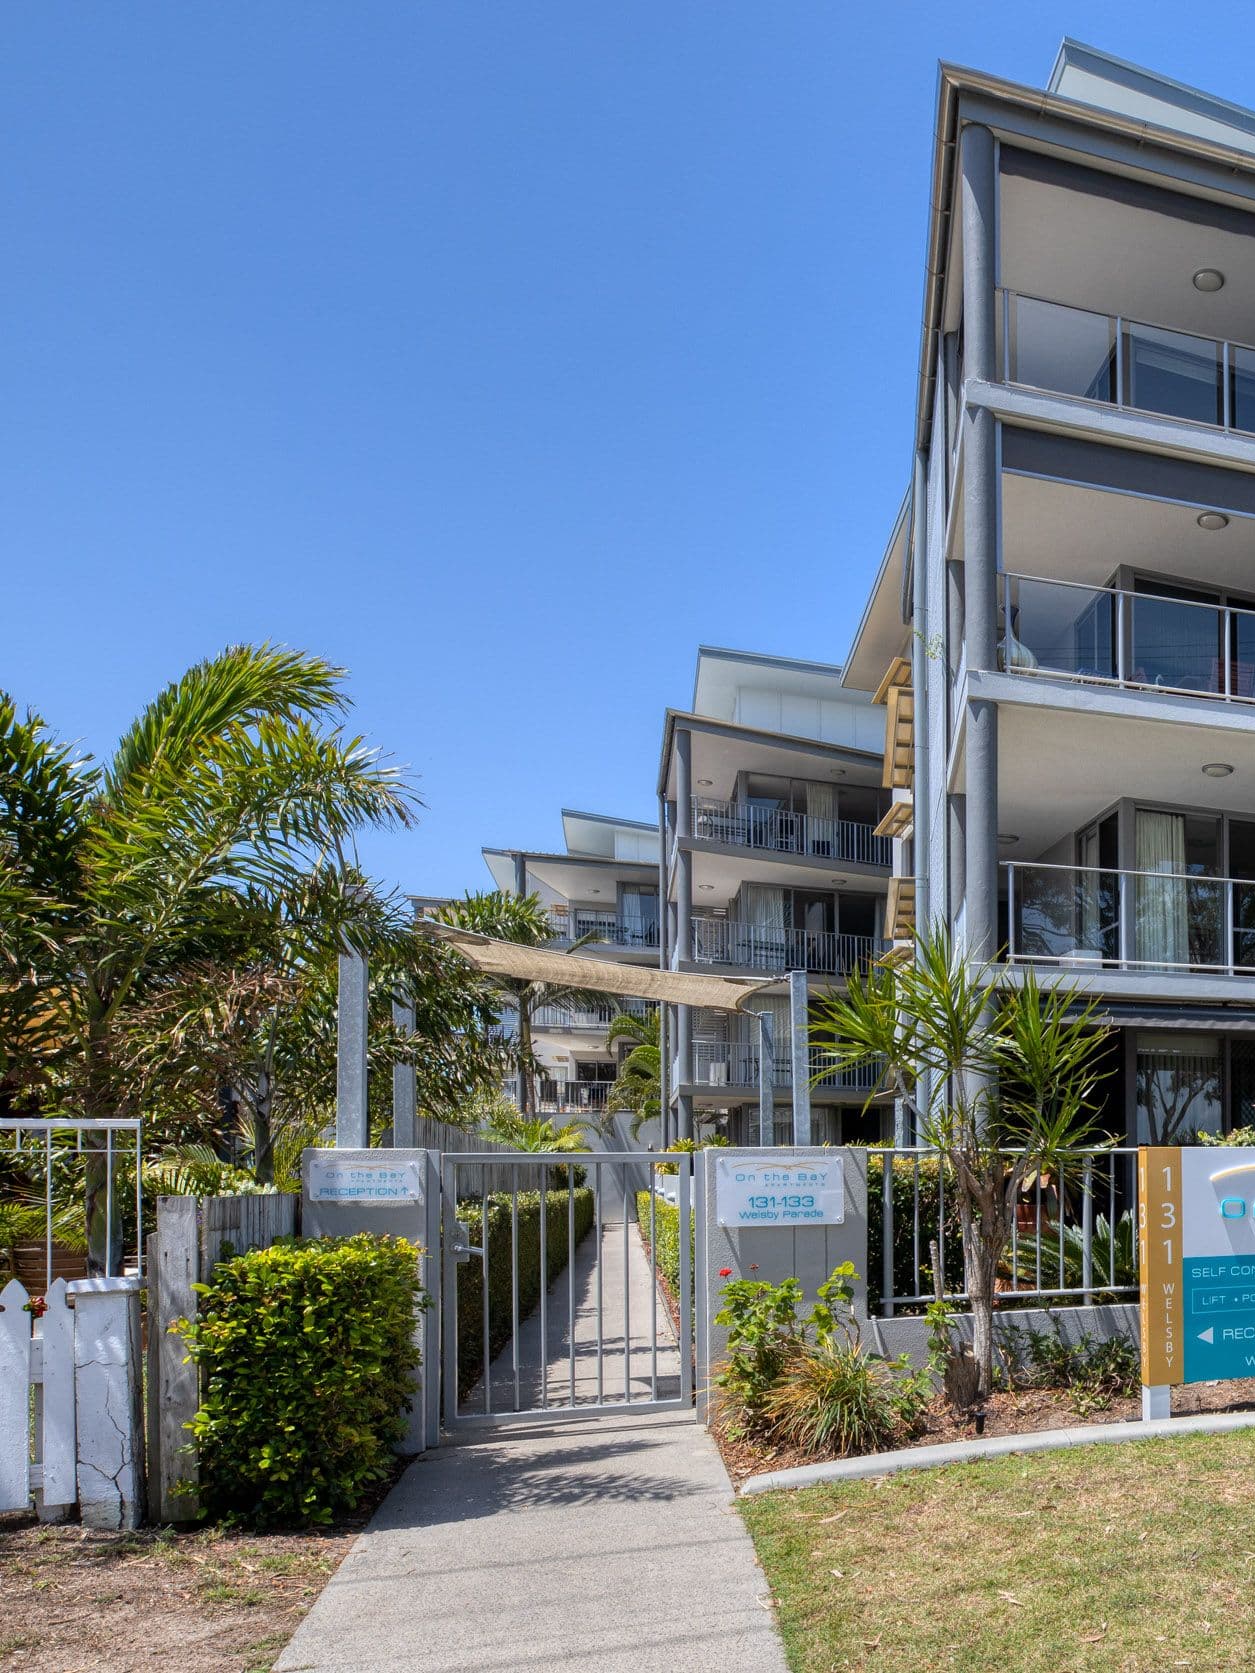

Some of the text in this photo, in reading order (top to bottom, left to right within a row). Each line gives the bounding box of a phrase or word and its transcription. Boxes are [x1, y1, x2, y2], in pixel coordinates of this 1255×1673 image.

[350, 1171, 373, 1179] the
[735, 1173, 756, 1182] On
[764, 1172, 790, 1181] the
[319, 1187, 398, 1196] RECEPTION
[748, 1195, 815, 1208] 131-133
[739, 1209, 824, 1221] Welsby Parade
[1191, 1266, 1227, 1278] SELF
[1202, 1295, 1226, 1306] LIFT
[1162, 1283, 1175, 1368] WELSBY
